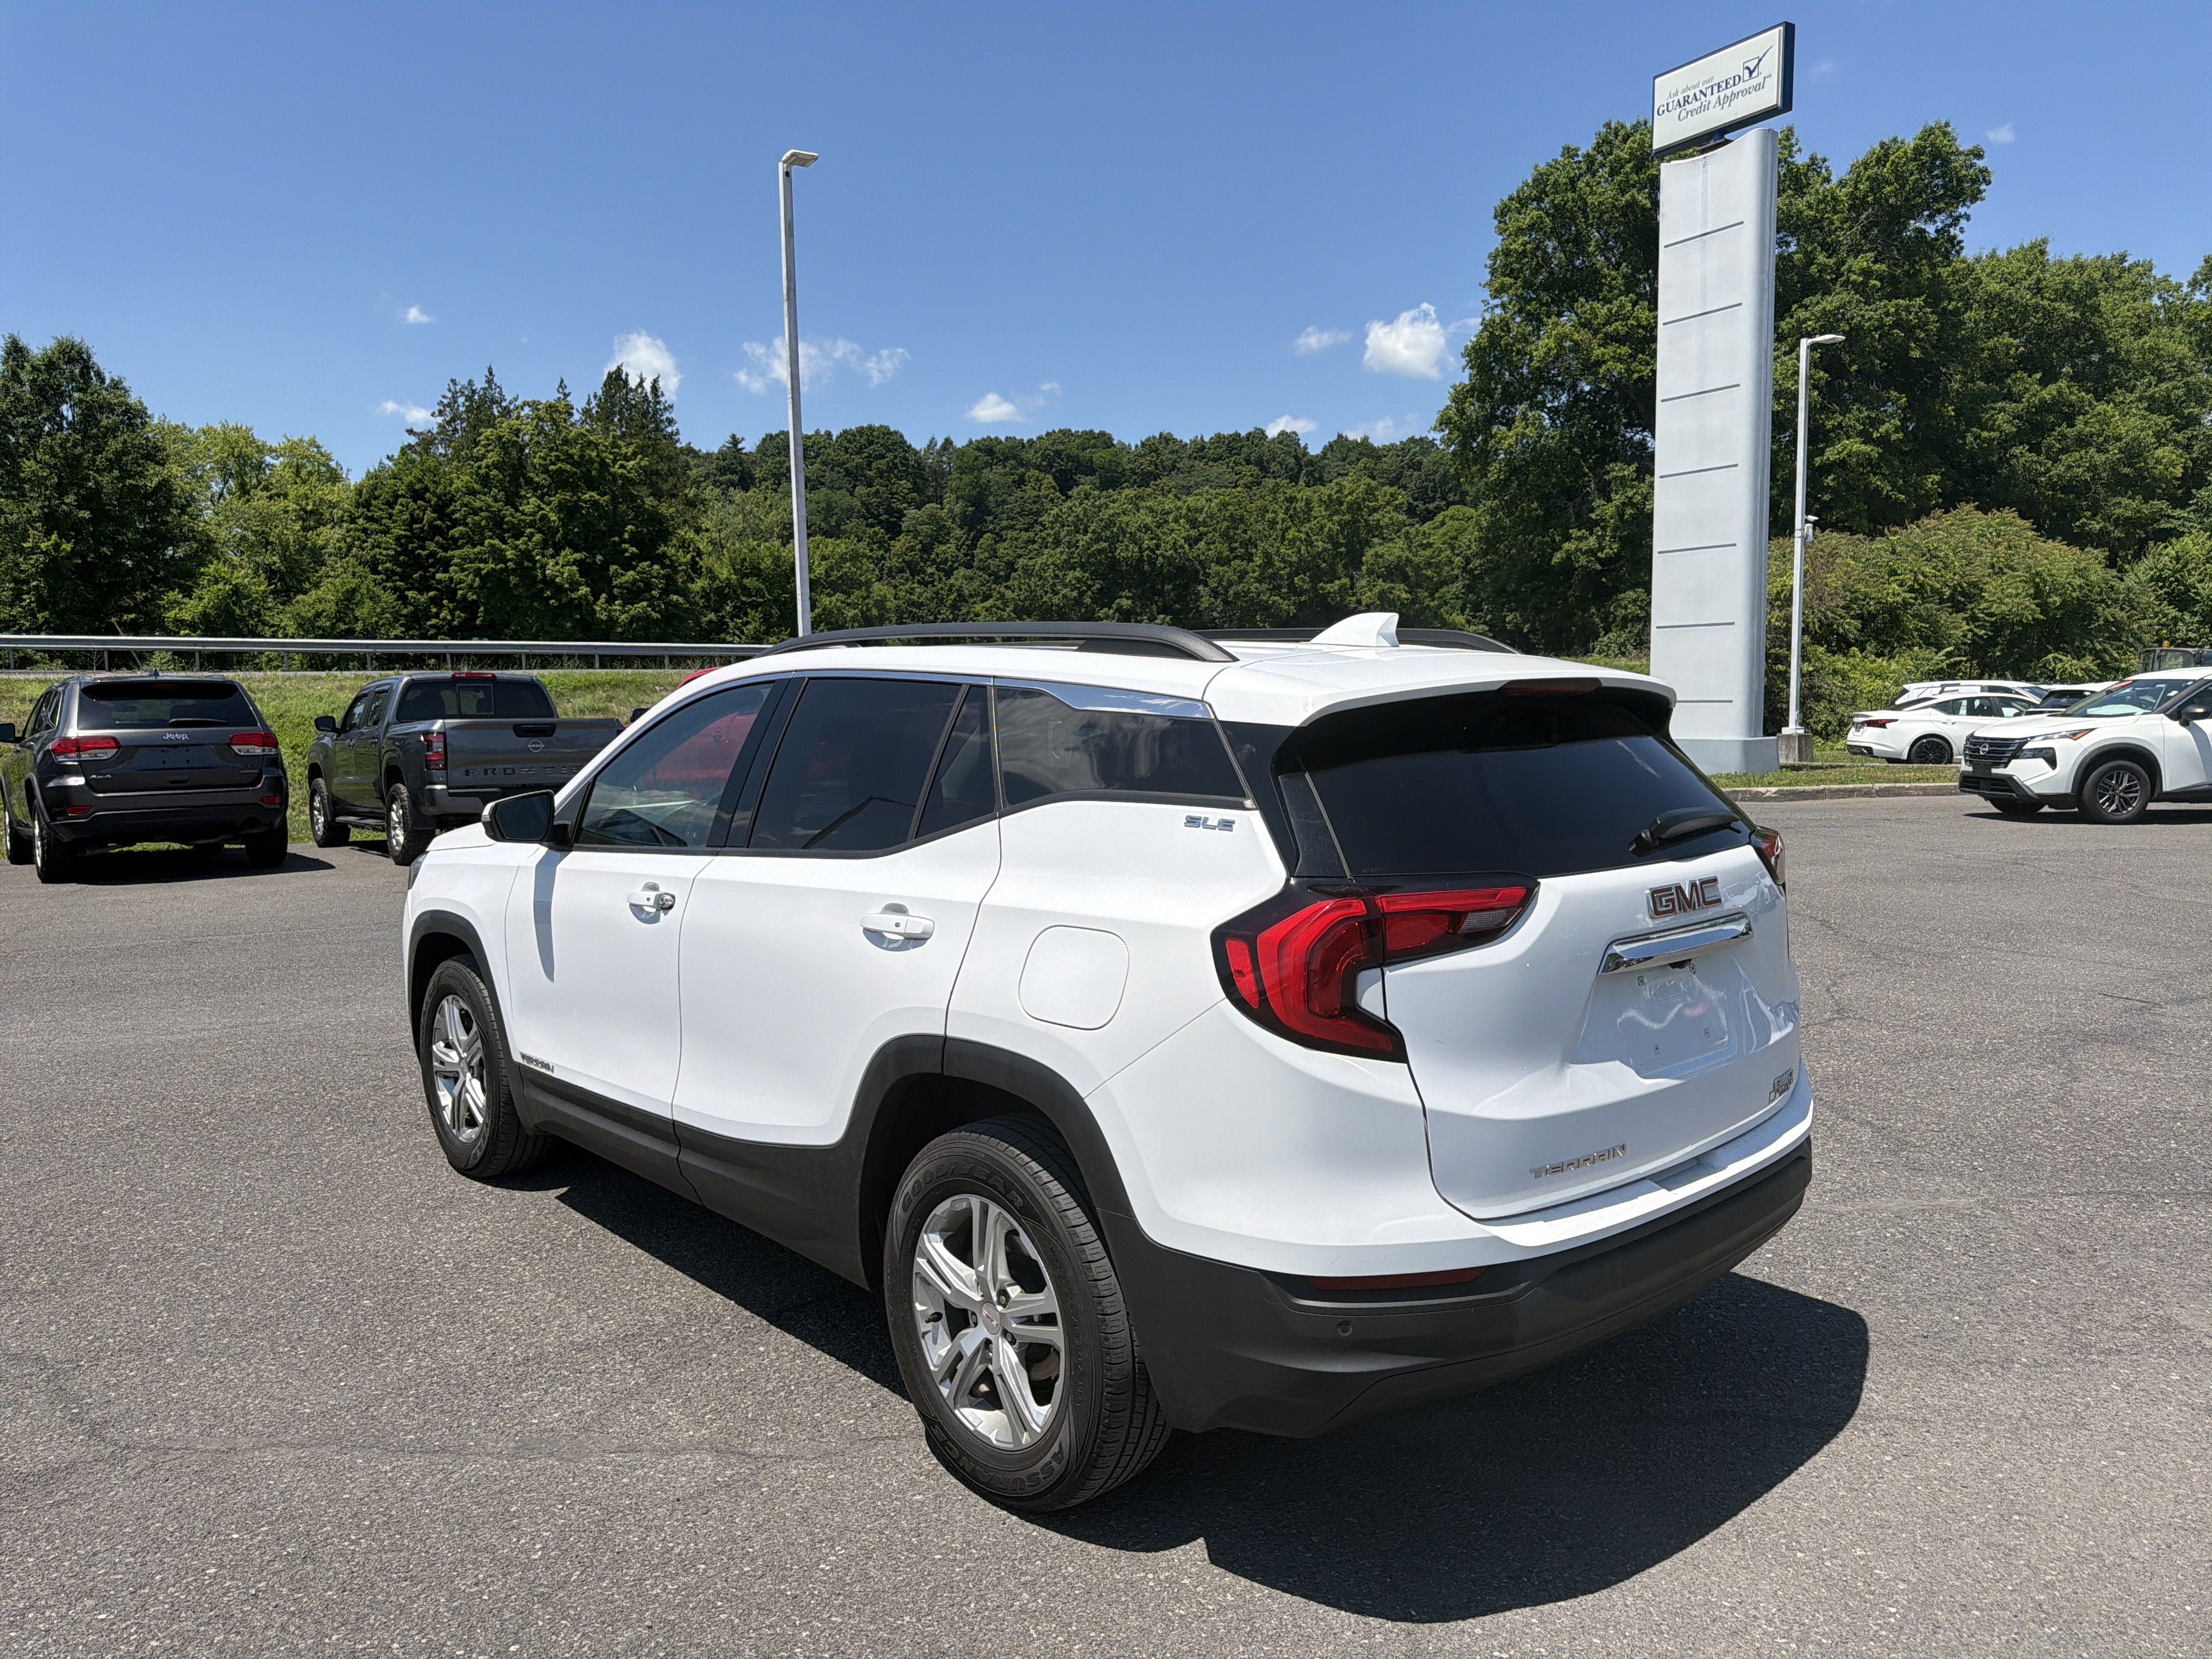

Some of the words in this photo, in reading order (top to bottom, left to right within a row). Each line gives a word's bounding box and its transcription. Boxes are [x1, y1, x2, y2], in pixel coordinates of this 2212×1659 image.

[1656, 74, 1741, 116] GUARANTEED
[1666, 91, 1679, 100] Ask
[1681, 81, 1700, 95] about
[1700, 76, 1714, 86] our
[1678, 98, 1711, 121] Credit
[1713, 76, 1767, 110] Approval
[465, 766, 585, 776] FRONTIE
[1184, 815, 1235, 832] SLE
[1645, 876, 1722, 919] GMC
[1530, 1143, 1627, 1178] TERRAIN
[901, 1161, 1024, 1212] GOODYEAR
